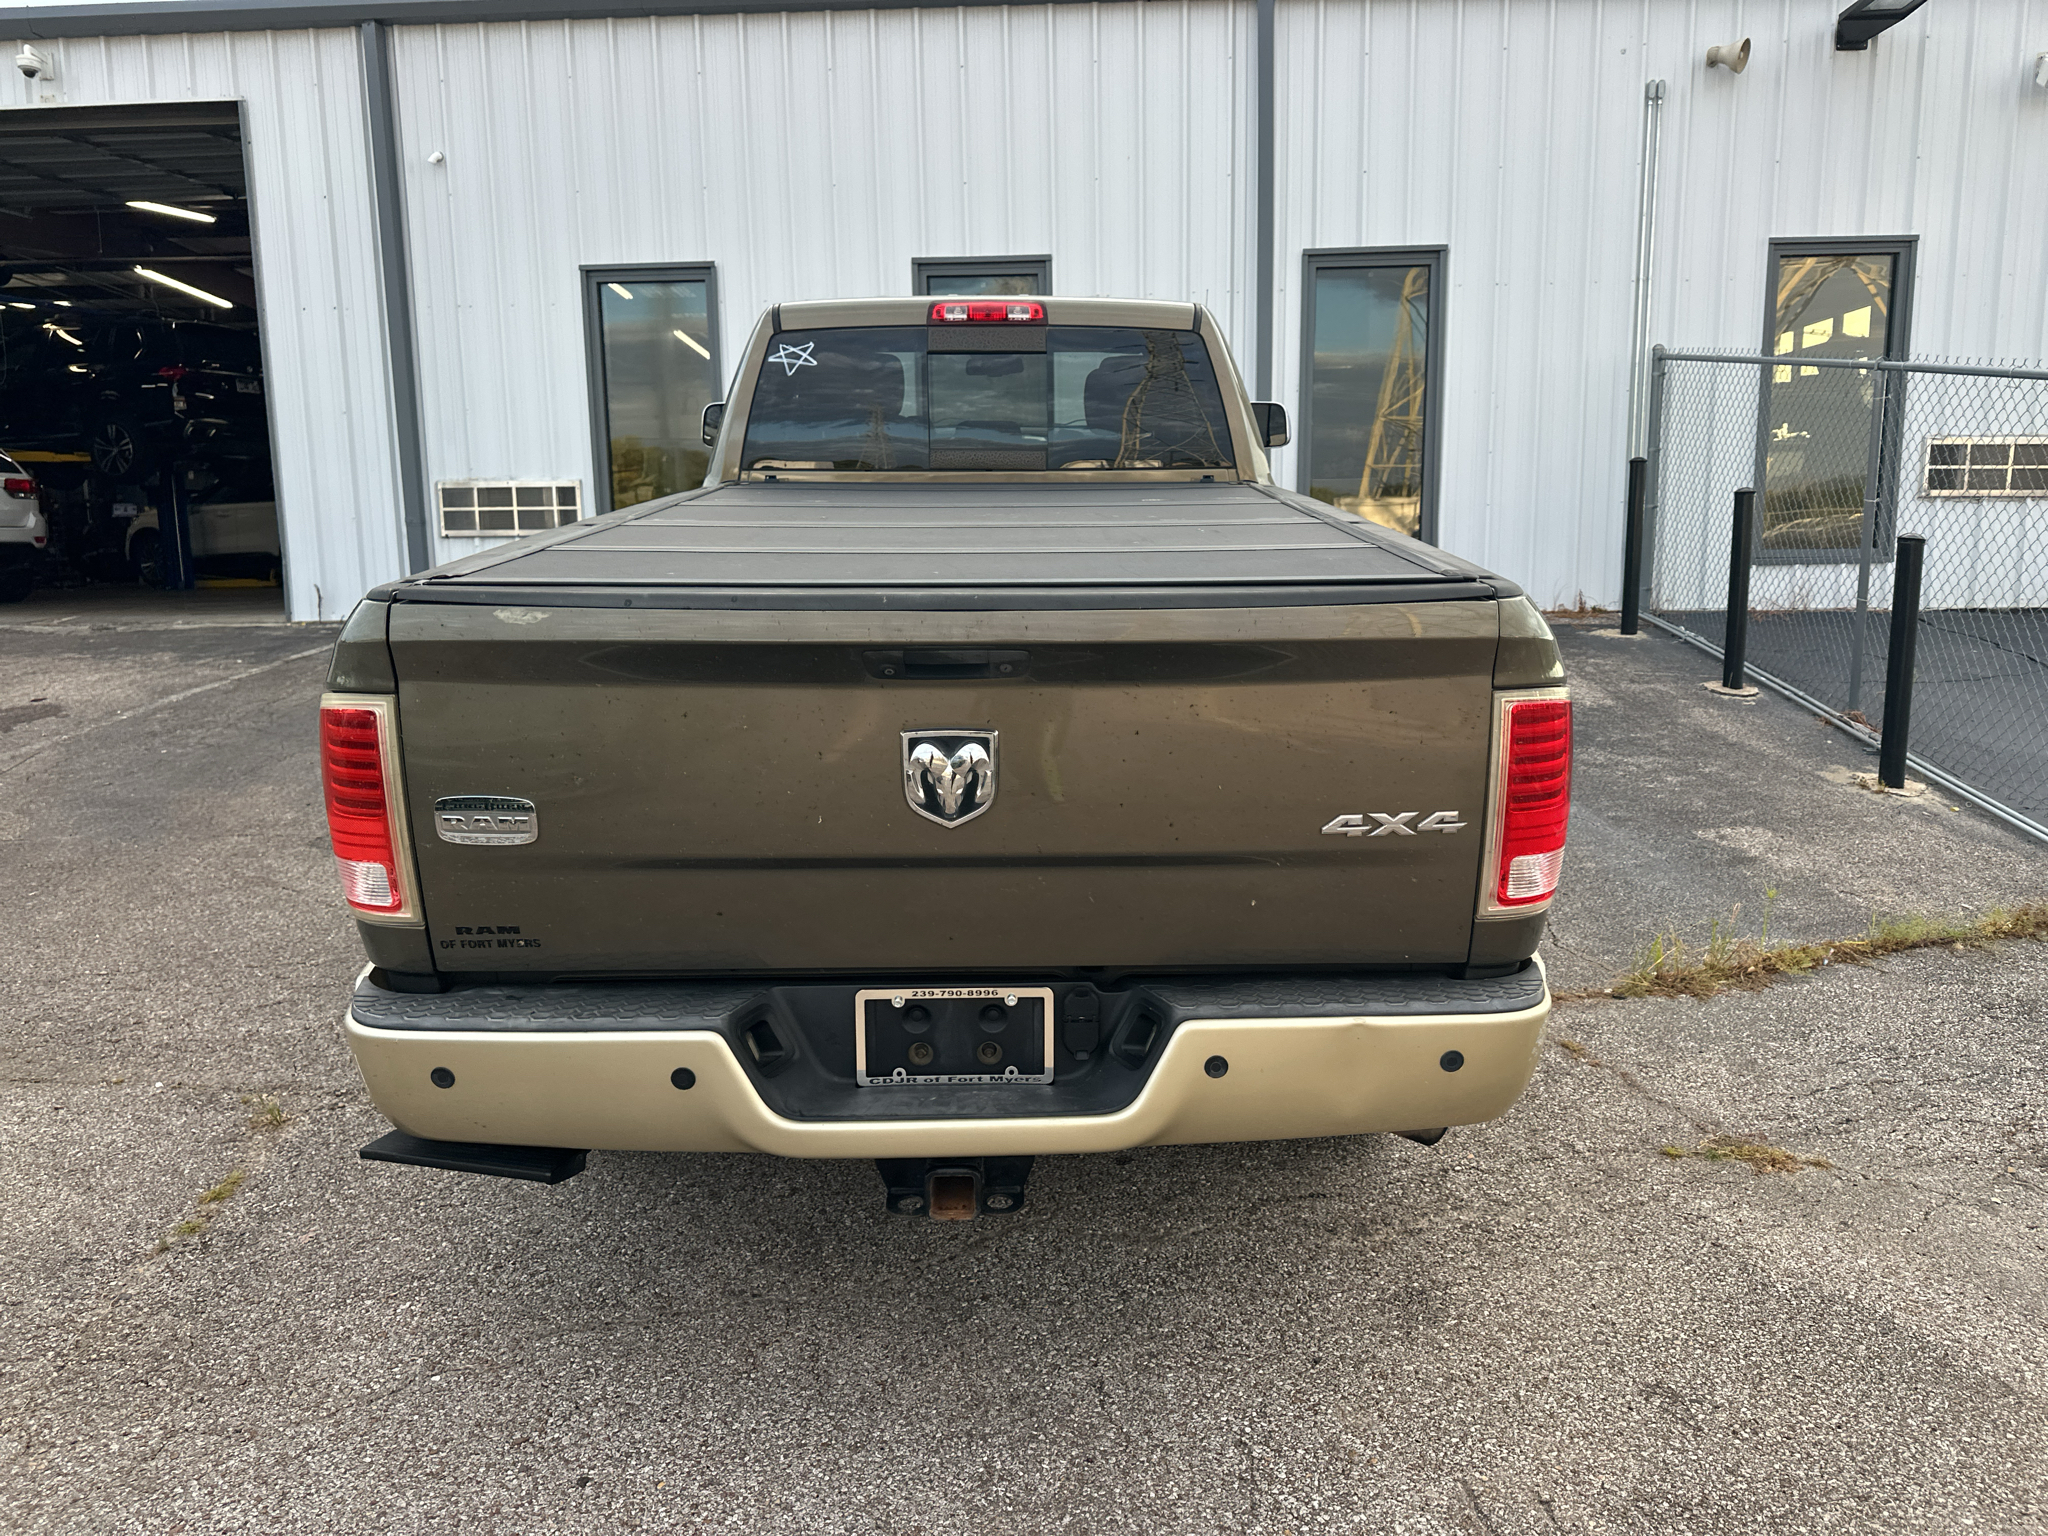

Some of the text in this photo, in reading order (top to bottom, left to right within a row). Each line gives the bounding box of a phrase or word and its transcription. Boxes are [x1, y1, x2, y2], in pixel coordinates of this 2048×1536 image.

[441, 815, 530, 831] RAM
[455, 925, 521, 936] RAM
[440, 938, 541, 949] OF FORT MYERS
[911, 989, 999, 998] 239-790-8996
[869, 1075, 1042, 1085] CDJR of Fort Myers
